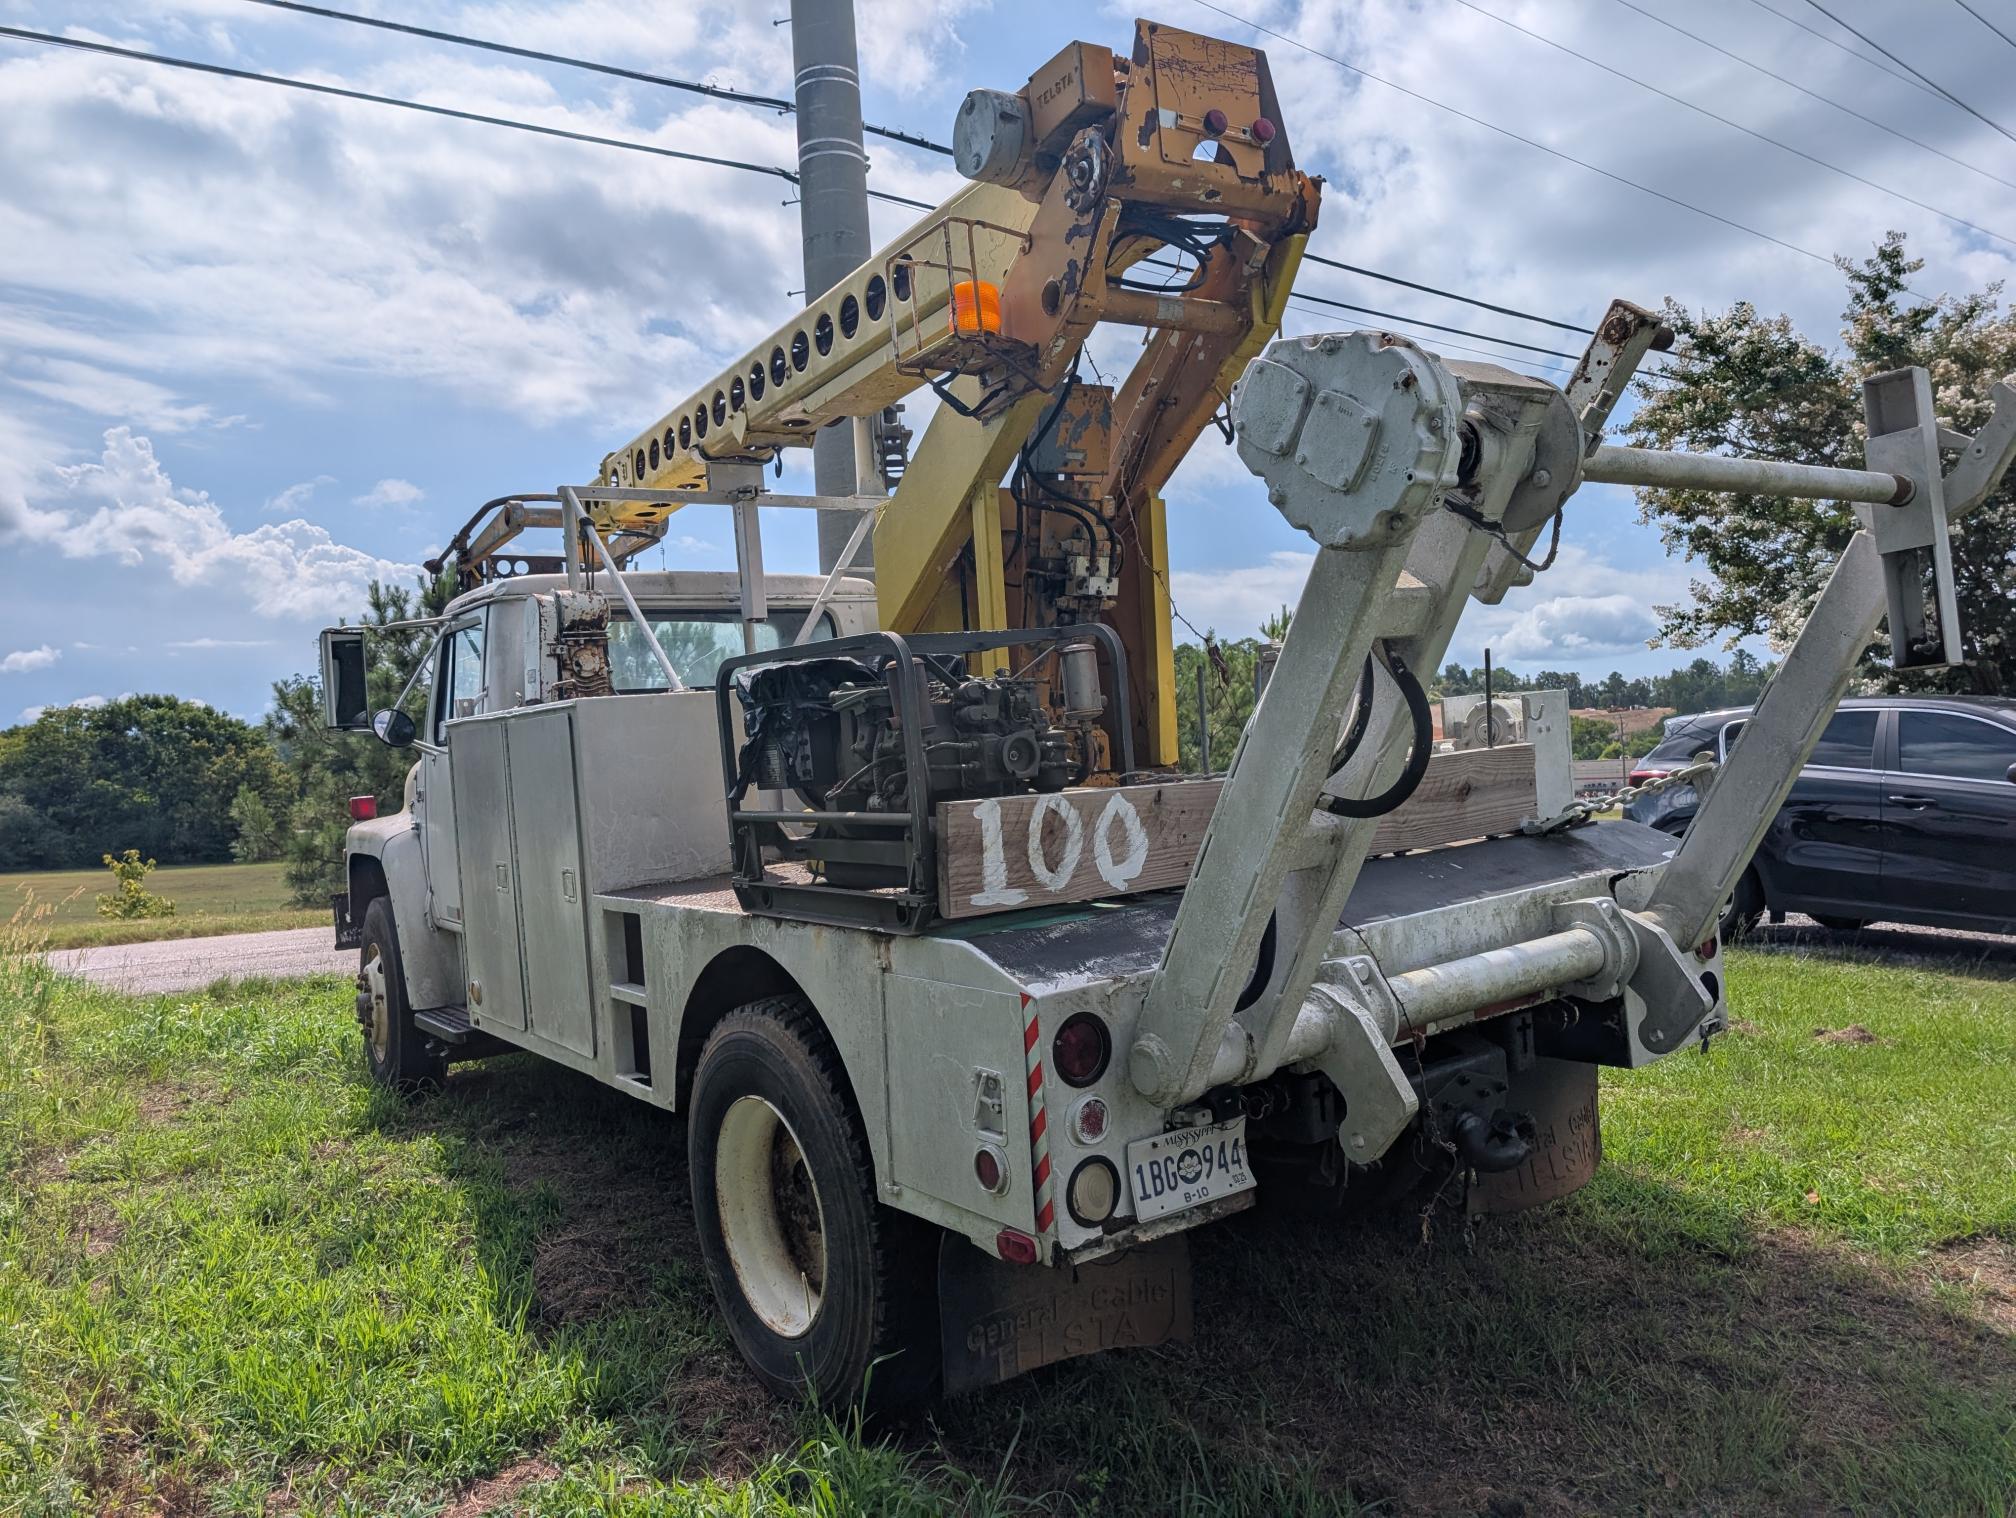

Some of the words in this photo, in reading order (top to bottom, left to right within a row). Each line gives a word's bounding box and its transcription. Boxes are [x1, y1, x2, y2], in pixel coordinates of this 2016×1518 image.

[1037, 73, 1074, 107] TELSTA
[970, 793, 1149, 905] 100
[1136, 1155, 1178, 1202] 1BG
[1202, 1137, 1242, 1180] 944
[1183, 1186, 1210, 1203] B-10
